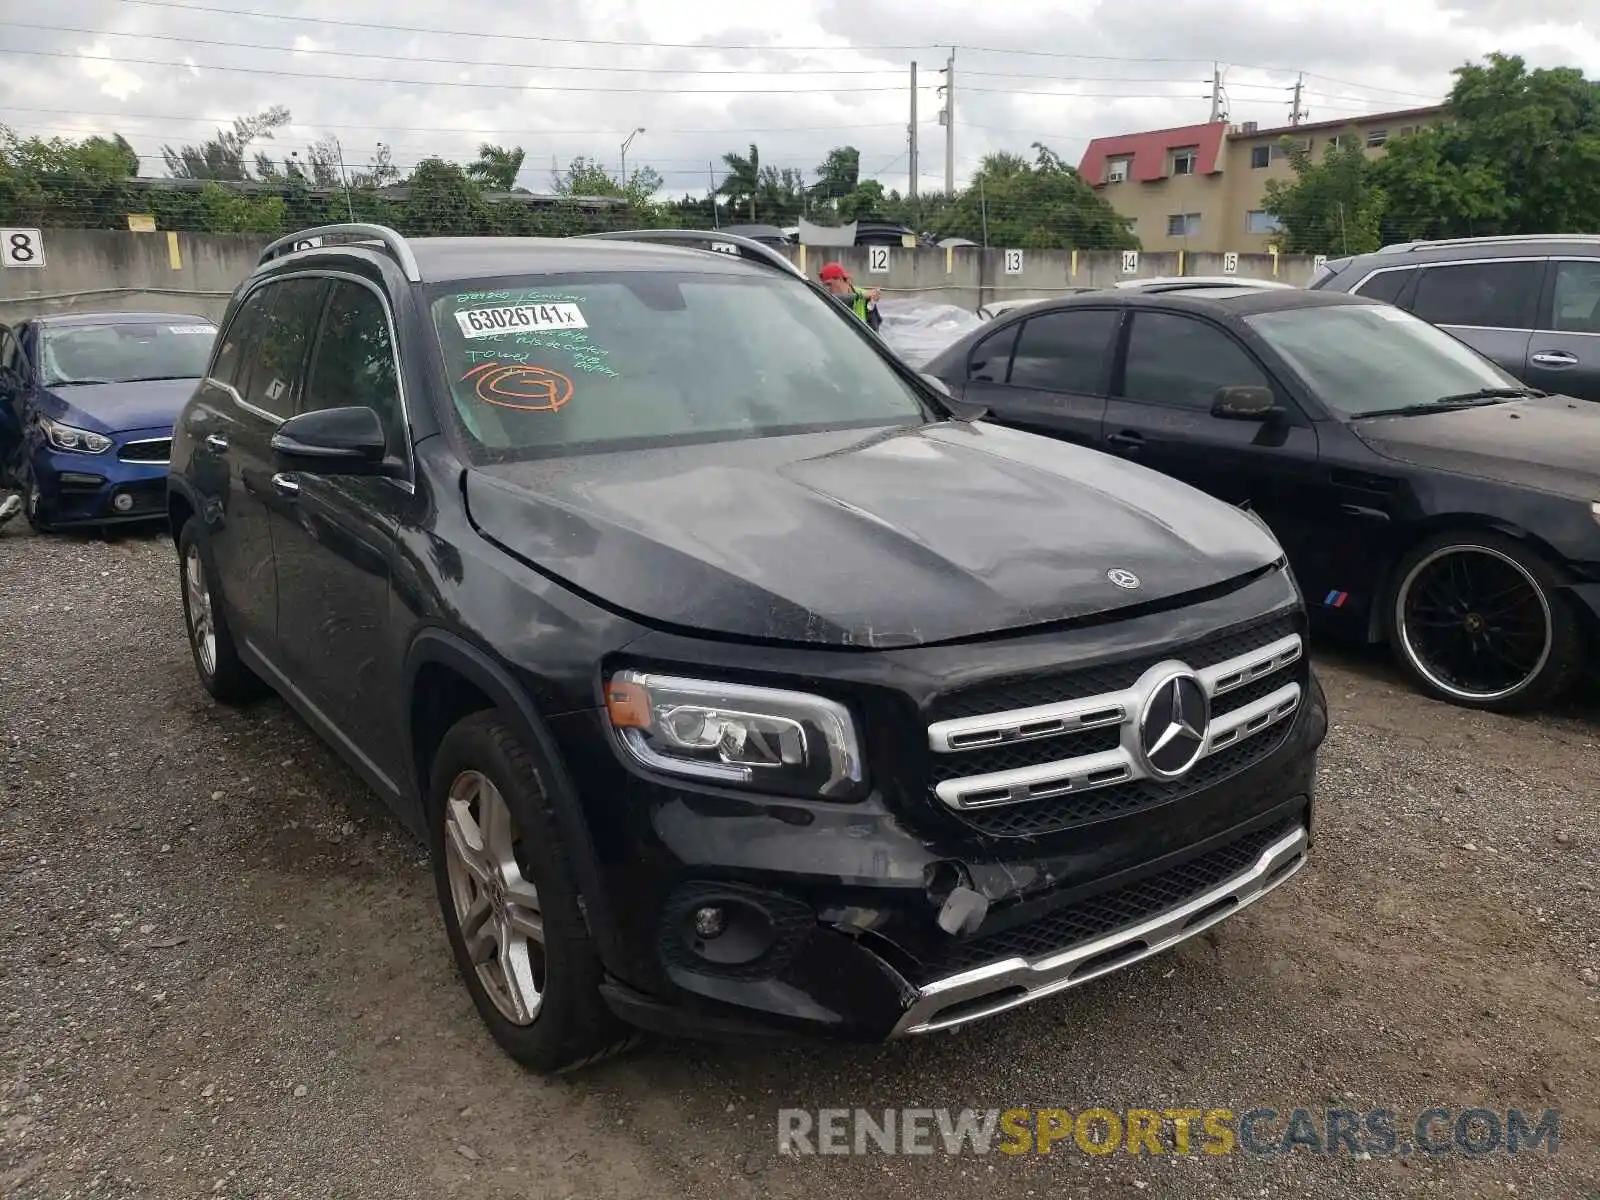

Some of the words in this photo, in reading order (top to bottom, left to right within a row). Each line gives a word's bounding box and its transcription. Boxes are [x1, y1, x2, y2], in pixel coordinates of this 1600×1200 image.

[10, 233, 34, 262] 8
[871, 249, 887, 270] 12
[1007, 252, 1020, 271] 13
[1123, 254, 1136, 271] 14
[1225, 255, 1236, 271] 15
[467, 305, 564, 330] 63026741
